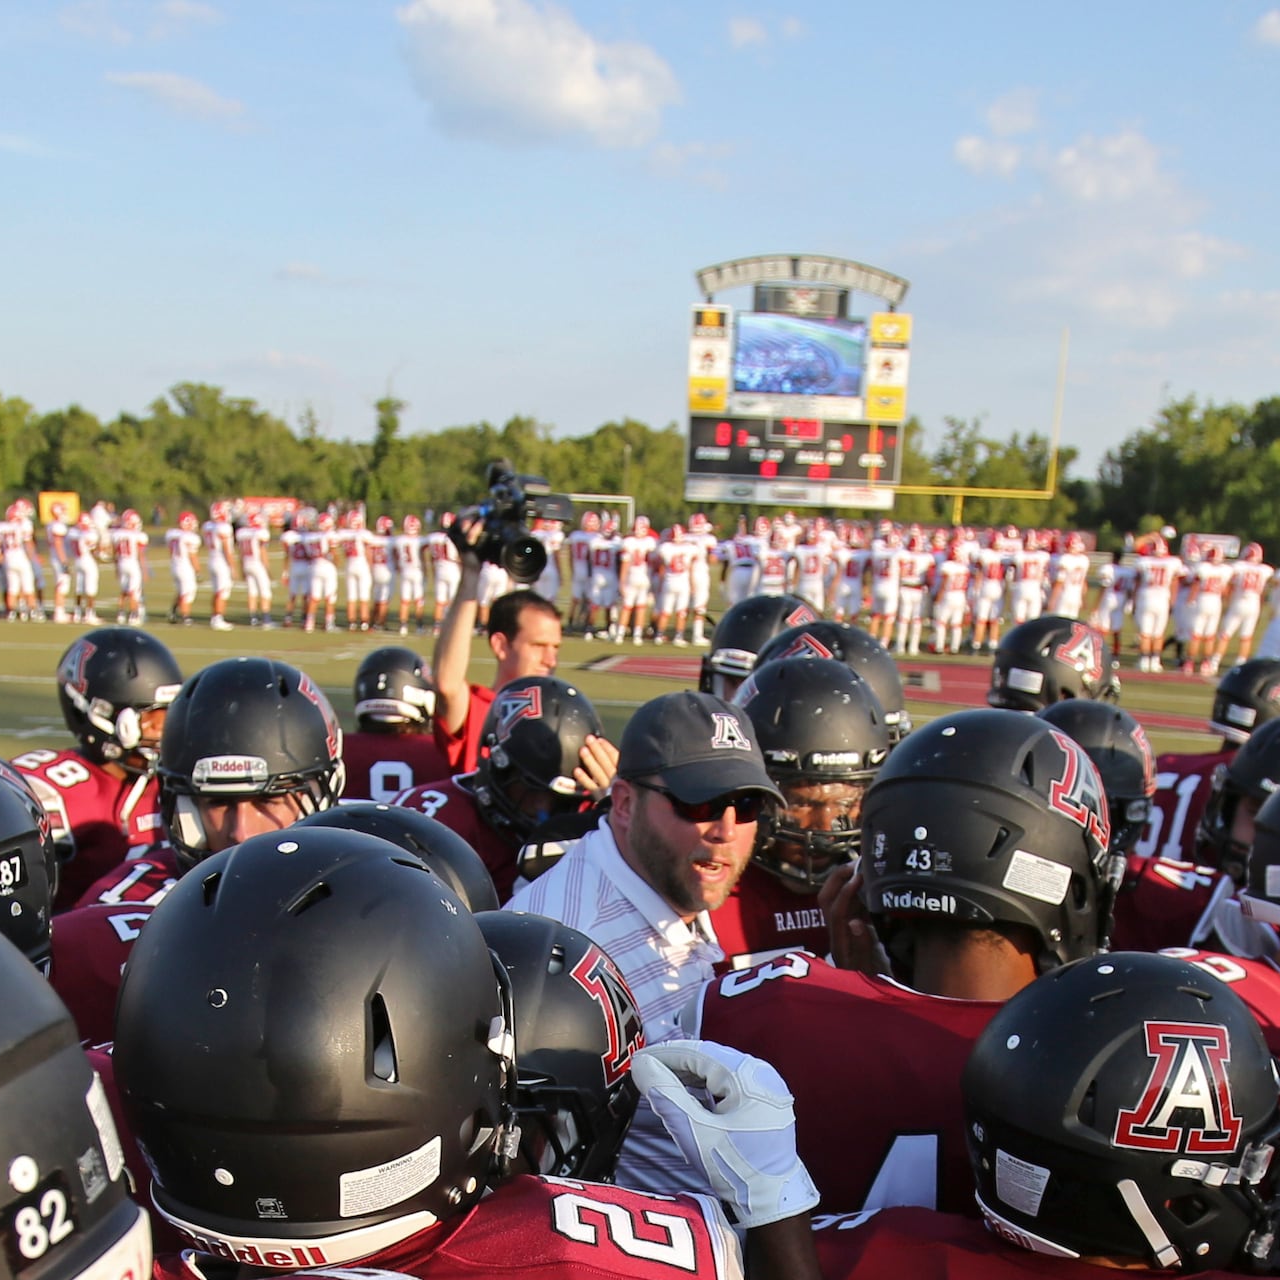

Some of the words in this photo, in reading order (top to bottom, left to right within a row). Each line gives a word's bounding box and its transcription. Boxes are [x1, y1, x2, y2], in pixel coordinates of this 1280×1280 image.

[57, 638, 98, 694] A
[1054, 622, 1104, 685] A
[495, 685, 543, 745] A
[711, 712, 753, 751] A
[11, 749, 91, 788] 28
[211, 759, 253, 773] Riddell
[1048, 728, 1114, 851] A
[0, 855, 21, 887] 87
[906, 848, 932, 871] 43
[881, 889, 957, 915] Riddell
[720, 948, 817, 998] 3
[569, 944, 647, 1089] A
[1112, 1020, 1244, 1155] A
[972, 1121, 985, 1143] 46
[378, 1156, 414, 1175] WARNING
[14, 1188, 75, 1260] 82
